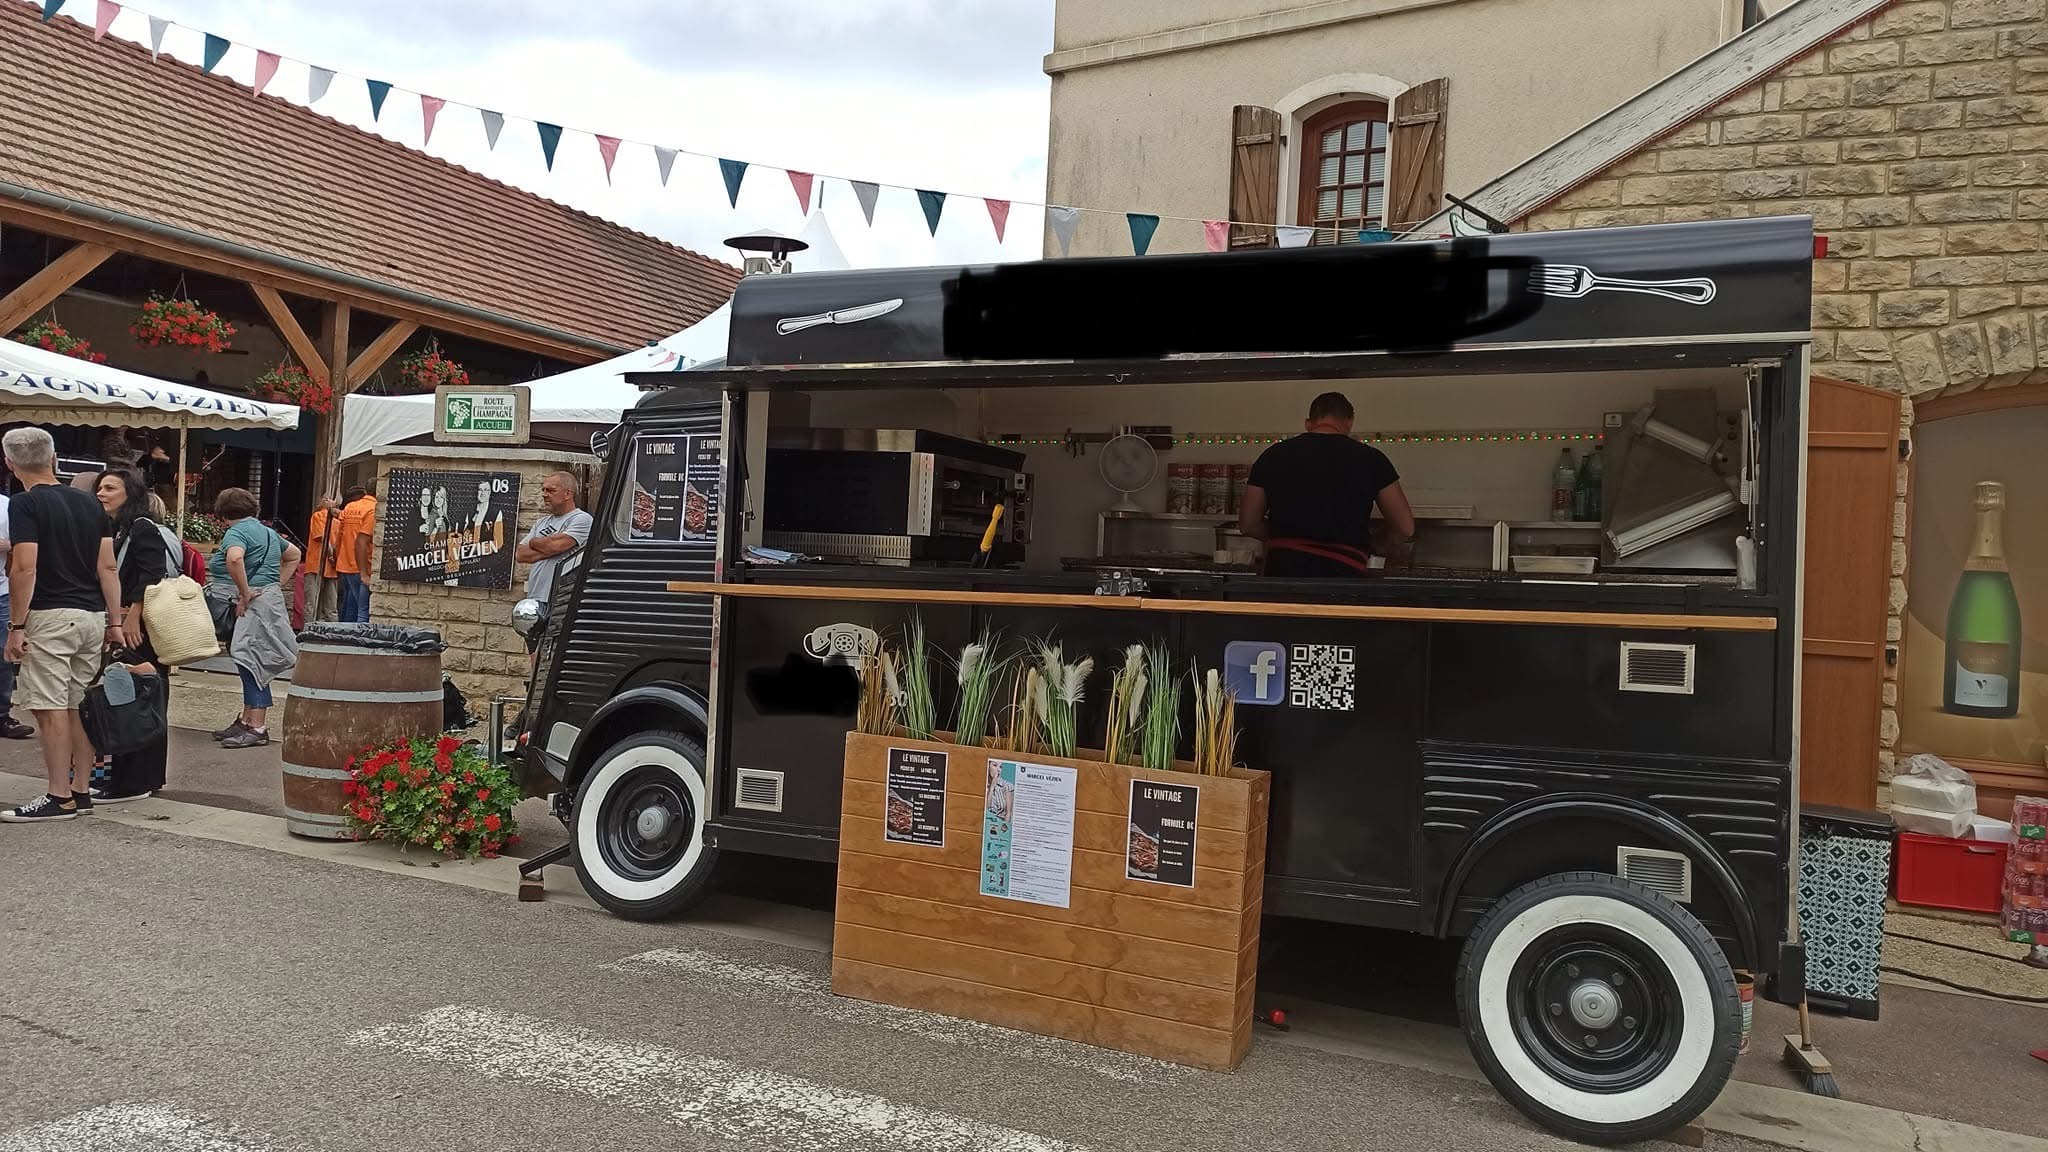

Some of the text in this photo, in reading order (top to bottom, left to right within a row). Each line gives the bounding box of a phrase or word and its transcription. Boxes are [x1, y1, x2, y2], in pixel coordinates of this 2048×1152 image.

[139, 388, 269, 417] VEZIEN
[483, 397, 504, 405] ROUTE
[473, 406, 512, 418] CHAMPAGNE
[475, 421, 509, 429] ACCUEIL
[646, 443, 675, 454] LE VINTAGE
[492, 479, 509, 493] 08
[424, 534, 473, 550] CHAMPAGNE
[396, 539, 498, 571] MARCEL VÉZIEN
[902, 753, 930, 765] LE VINTAGE
[1144, 788, 1182, 803] LE VINTAGE
[1161, 817, 1184, 829] FORMULE
